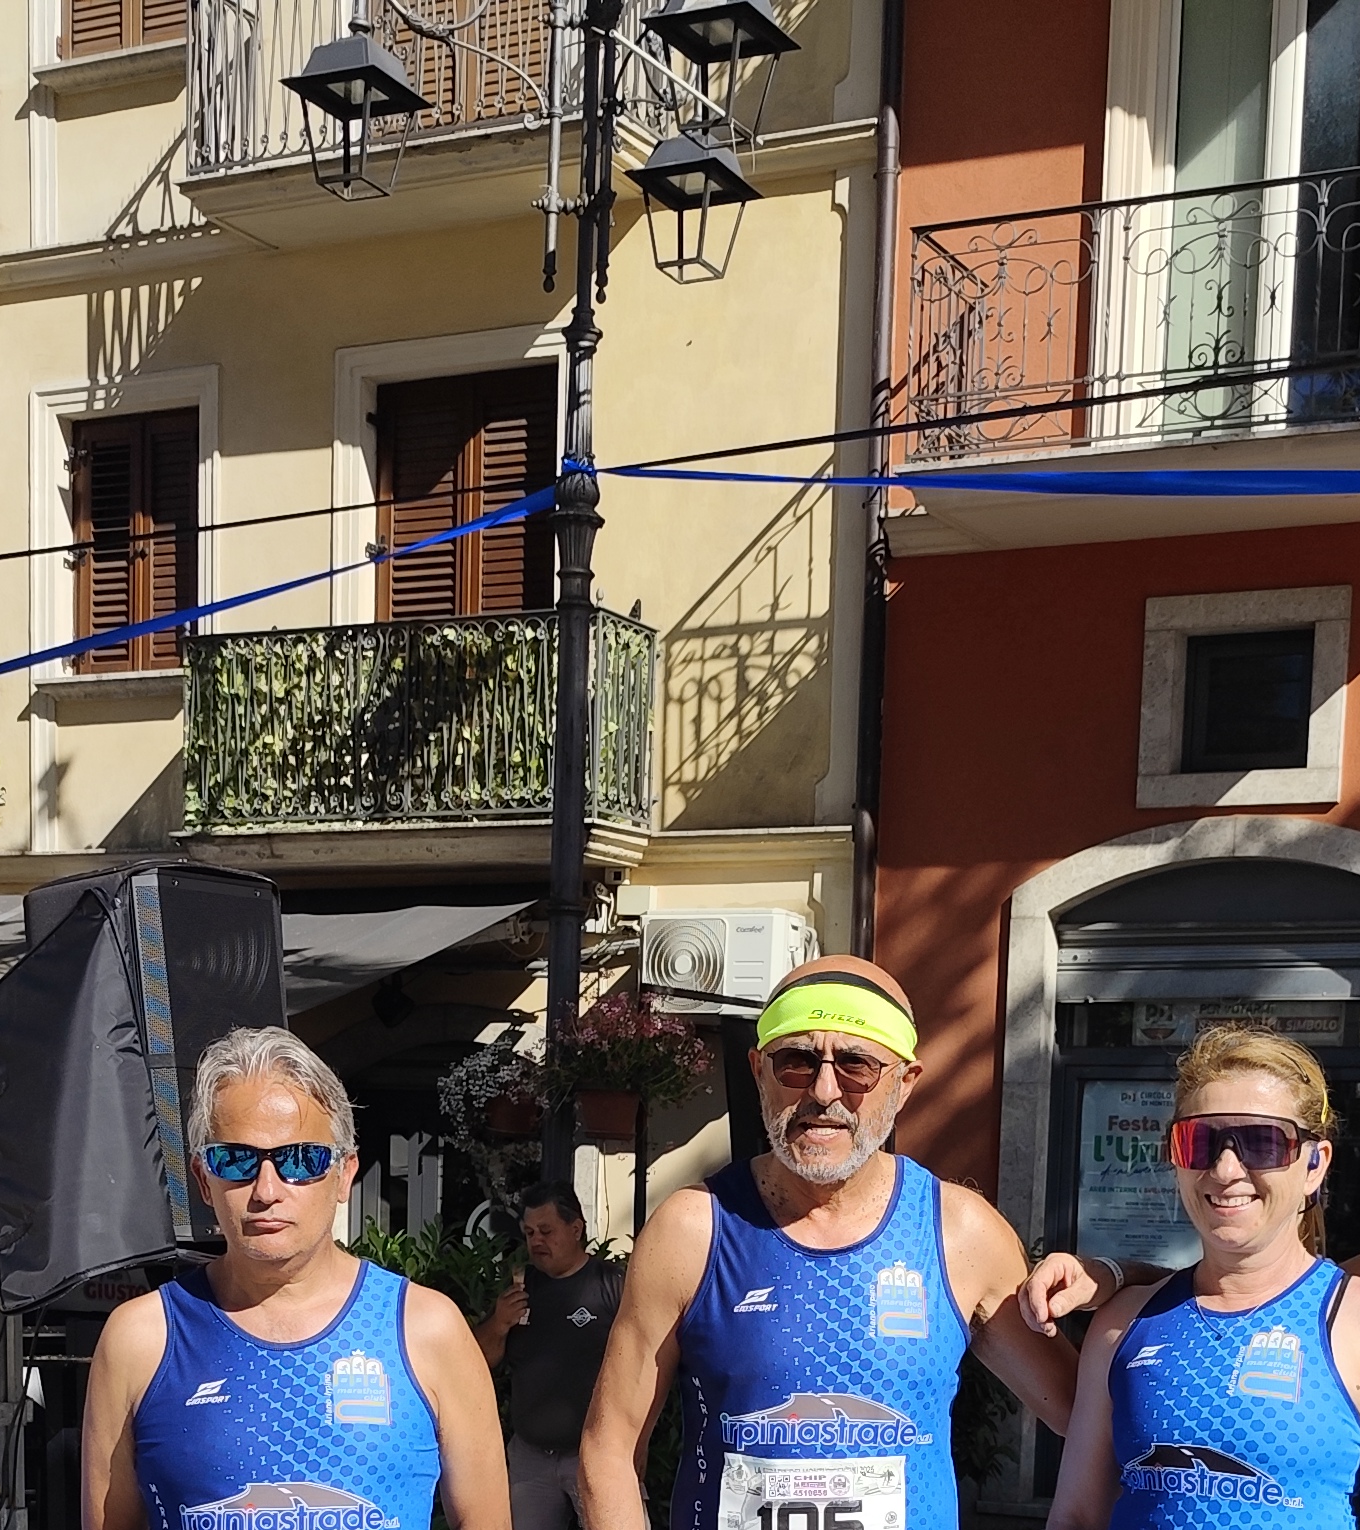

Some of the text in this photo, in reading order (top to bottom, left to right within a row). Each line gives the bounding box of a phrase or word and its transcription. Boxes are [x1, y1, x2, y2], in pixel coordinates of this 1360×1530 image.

[1285, 1019, 1338, 1032] SIMBOLO
[1107, 1114, 1161, 1132] Festa
[185, 1395, 231, 1407] GIOSPORT
[720, 1412, 918, 1451] irpiniastrade
[1283, 1497, 1305, 1509] s.r.l.
